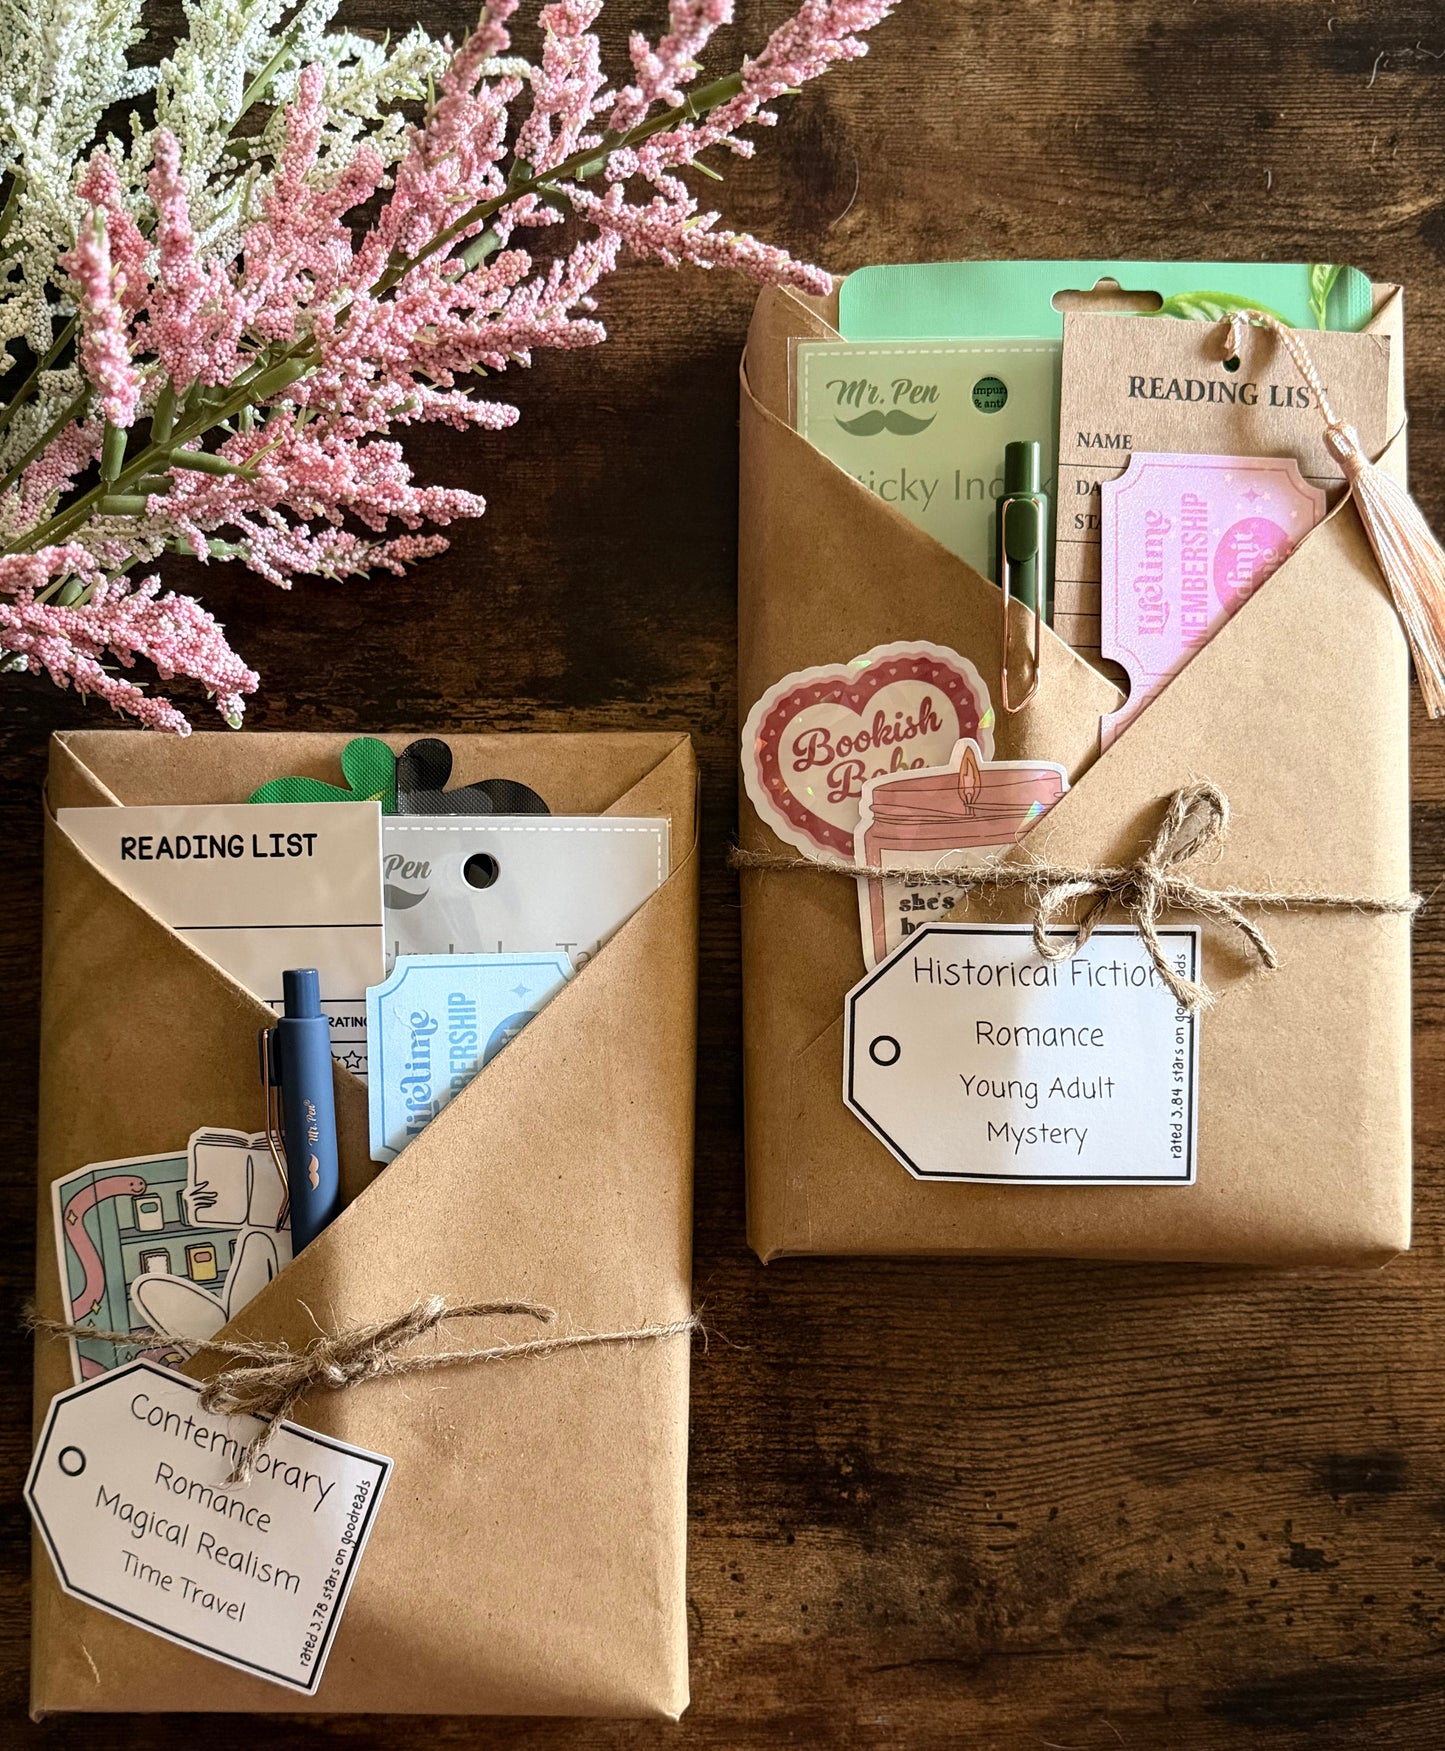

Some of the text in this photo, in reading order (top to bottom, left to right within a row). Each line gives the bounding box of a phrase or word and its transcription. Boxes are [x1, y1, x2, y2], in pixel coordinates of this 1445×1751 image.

[826, 379, 940, 408] Mr. Pen
[972, 387, 1007, 397] impur
[1127, 375, 1259, 406] READING
[1076, 431, 1133, 450] NAME
[850, 467, 940, 512] icky
[1075, 480, 1101, 496] DA
[792, 696, 943, 772] Bookish
[121, 833, 318, 861] READING LIST
[383, 854, 432, 880] Pen
[899, 892, 955, 912] she's
[914, 956, 1058, 987] Historical
[448, 992, 478, 1099] BERSHIP
[976, 1021, 1104, 1047] Romance
[1175, 1027, 1184, 1045] on
[1172, 1048, 1184, 1083] stars
[959, 1074, 1116, 1109] Young Adult
[1171, 1088, 1183, 1119] 3.84
[987, 1121, 1088, 1155] Mystery
[1169, 1123, 1183, 1159] rated
[155, 1462, 271, 1532] Romance
[96, 1484, 301, 1594] Magical Realism
[122, 1550, 246, 1622] Time Travel
[300, 1479, 371, 1667] rated 3.78 stars on goodreads
